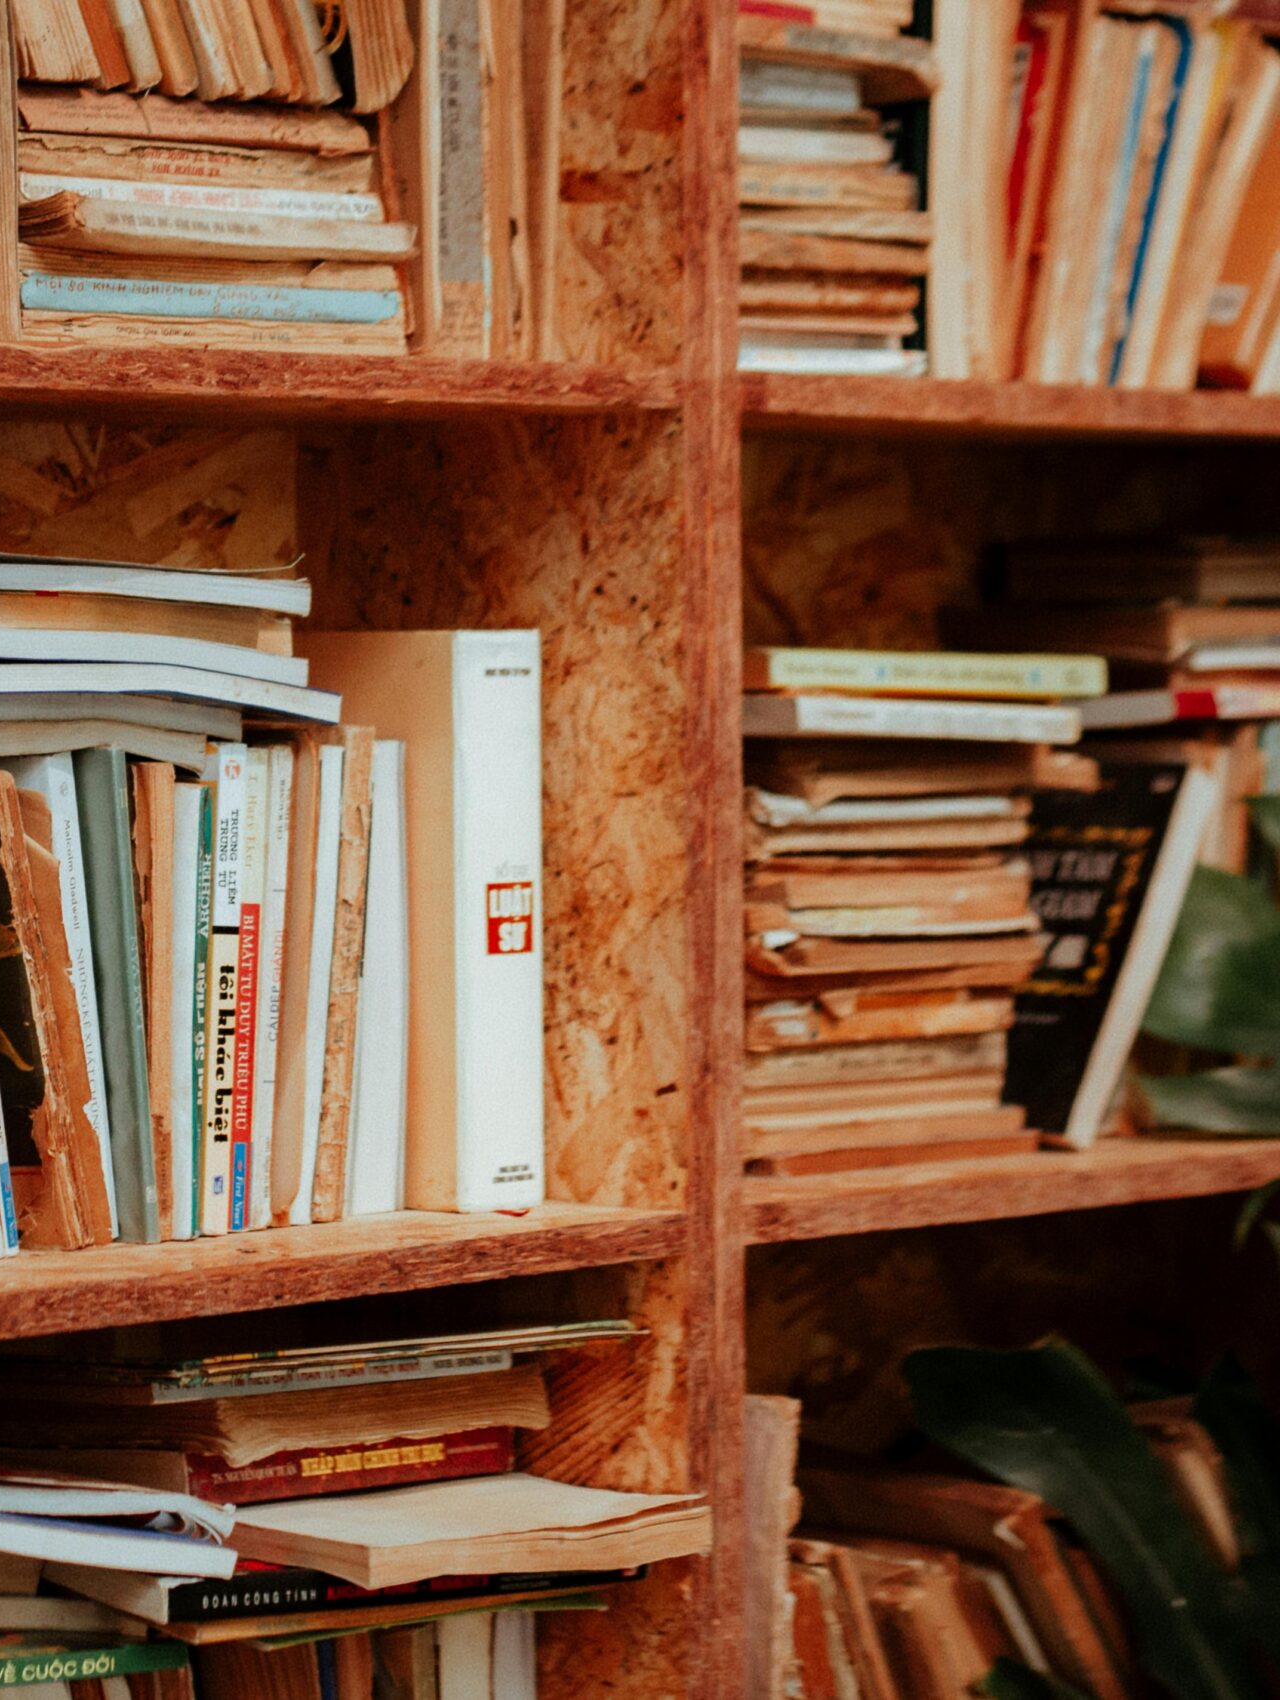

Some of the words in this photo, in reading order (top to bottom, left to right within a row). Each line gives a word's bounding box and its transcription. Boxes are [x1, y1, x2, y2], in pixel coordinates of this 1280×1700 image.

[64, 819, 75, 872] Malcolm
[244, 835, 257, 869] Eker
[69, 877, 81, 930] Gladwell
[488, 884, 532, 920] LUẬT
[242, 914, 256, 933] BÍ
[497, 921, 528, 952] SƯ
[219, 965, 235, 1000] tôi
[238, 1001, 251, 1037] DUY
[215, 1009, 236, 1081] khác
[208, 1088, 233, 1144] biệt
[234, 1175, 243, 1198] First
[233, 1200, 243, 1226] News
[202, 1591, 239, 1609] ĐOÀN
[244, 1588, 281, 1607] CÔNG
[285, 1585, 317, 1604] TÍNH
[21, 1658, 77, 1682] CUỘC
[81, 1654, 116, 1677] ĐỜI
